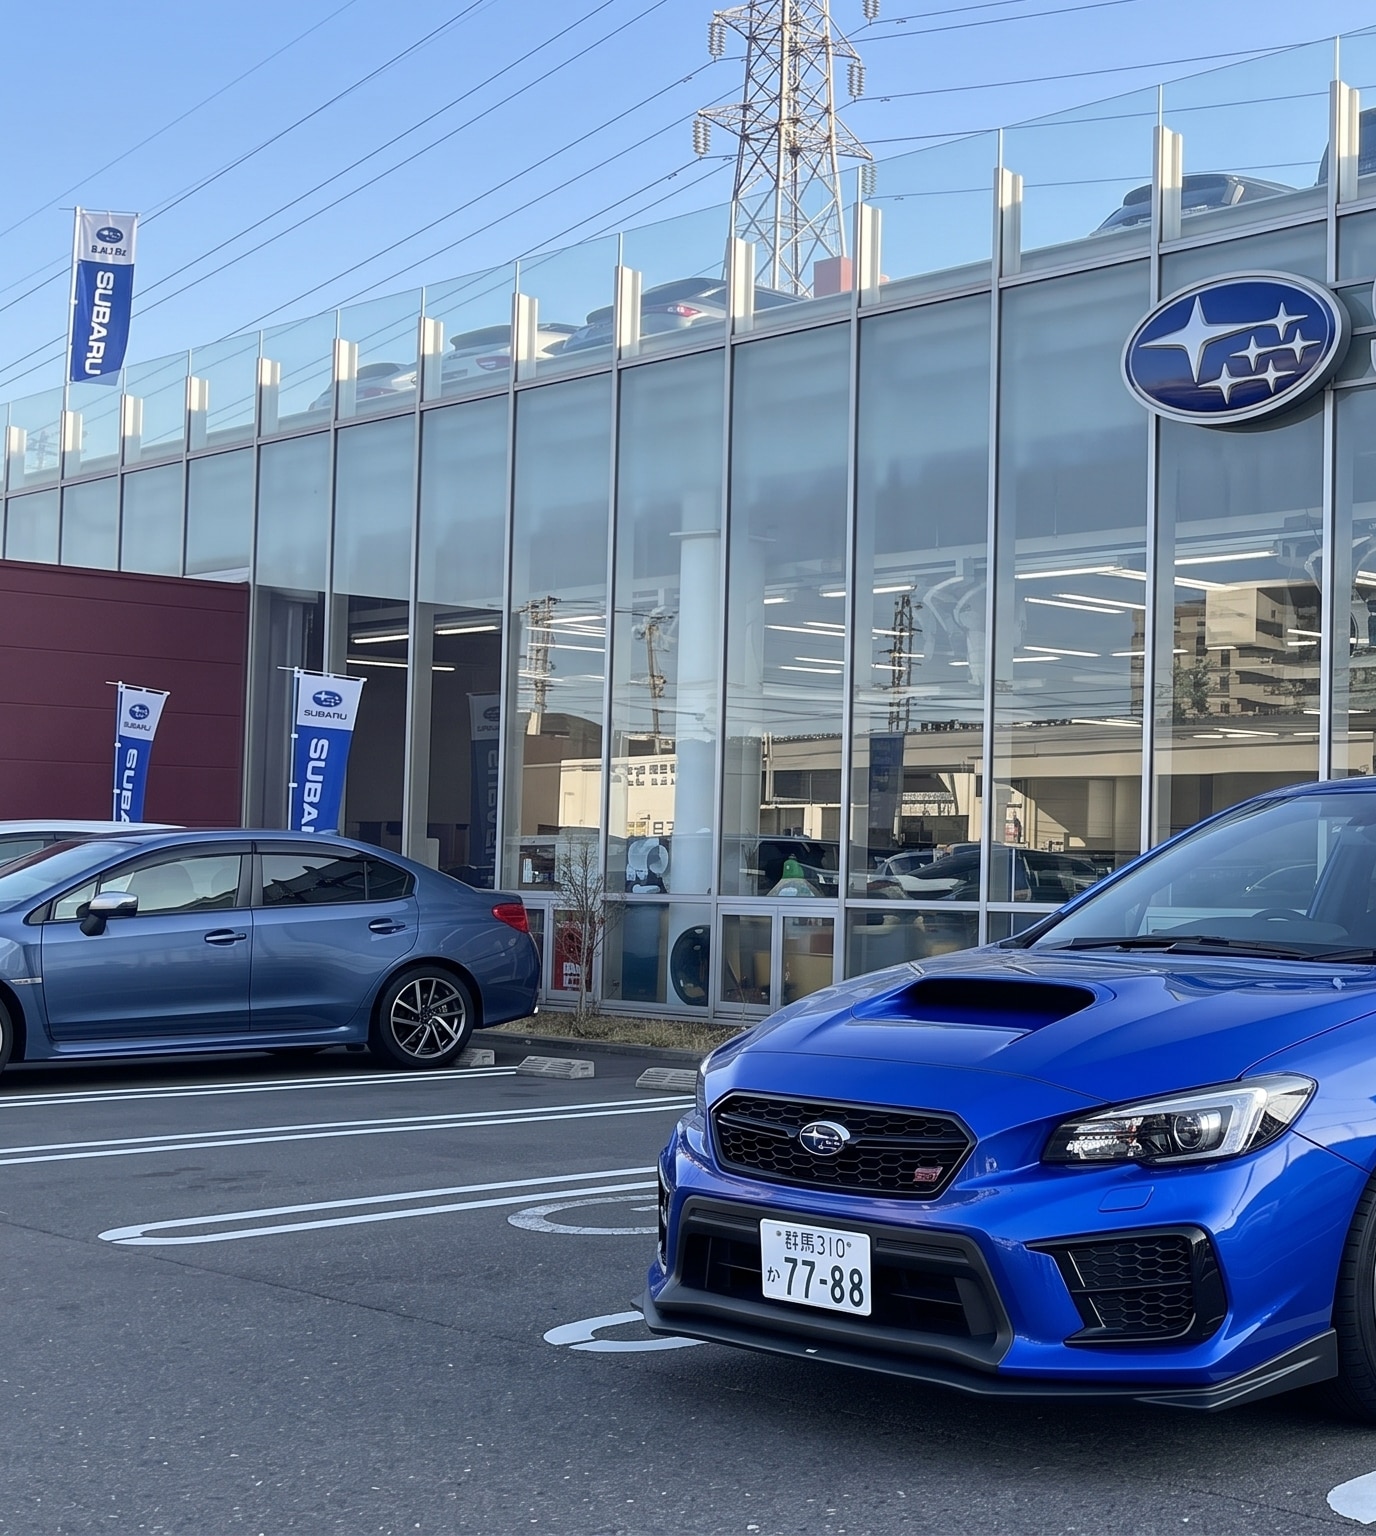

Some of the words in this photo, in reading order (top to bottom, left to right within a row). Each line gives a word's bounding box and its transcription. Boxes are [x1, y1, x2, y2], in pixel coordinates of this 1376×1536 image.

[85, 271, 115, 375] SUBARU
[767, 1266, 781, 1283] か
[784, 1256, 864, 1308] 77-88
